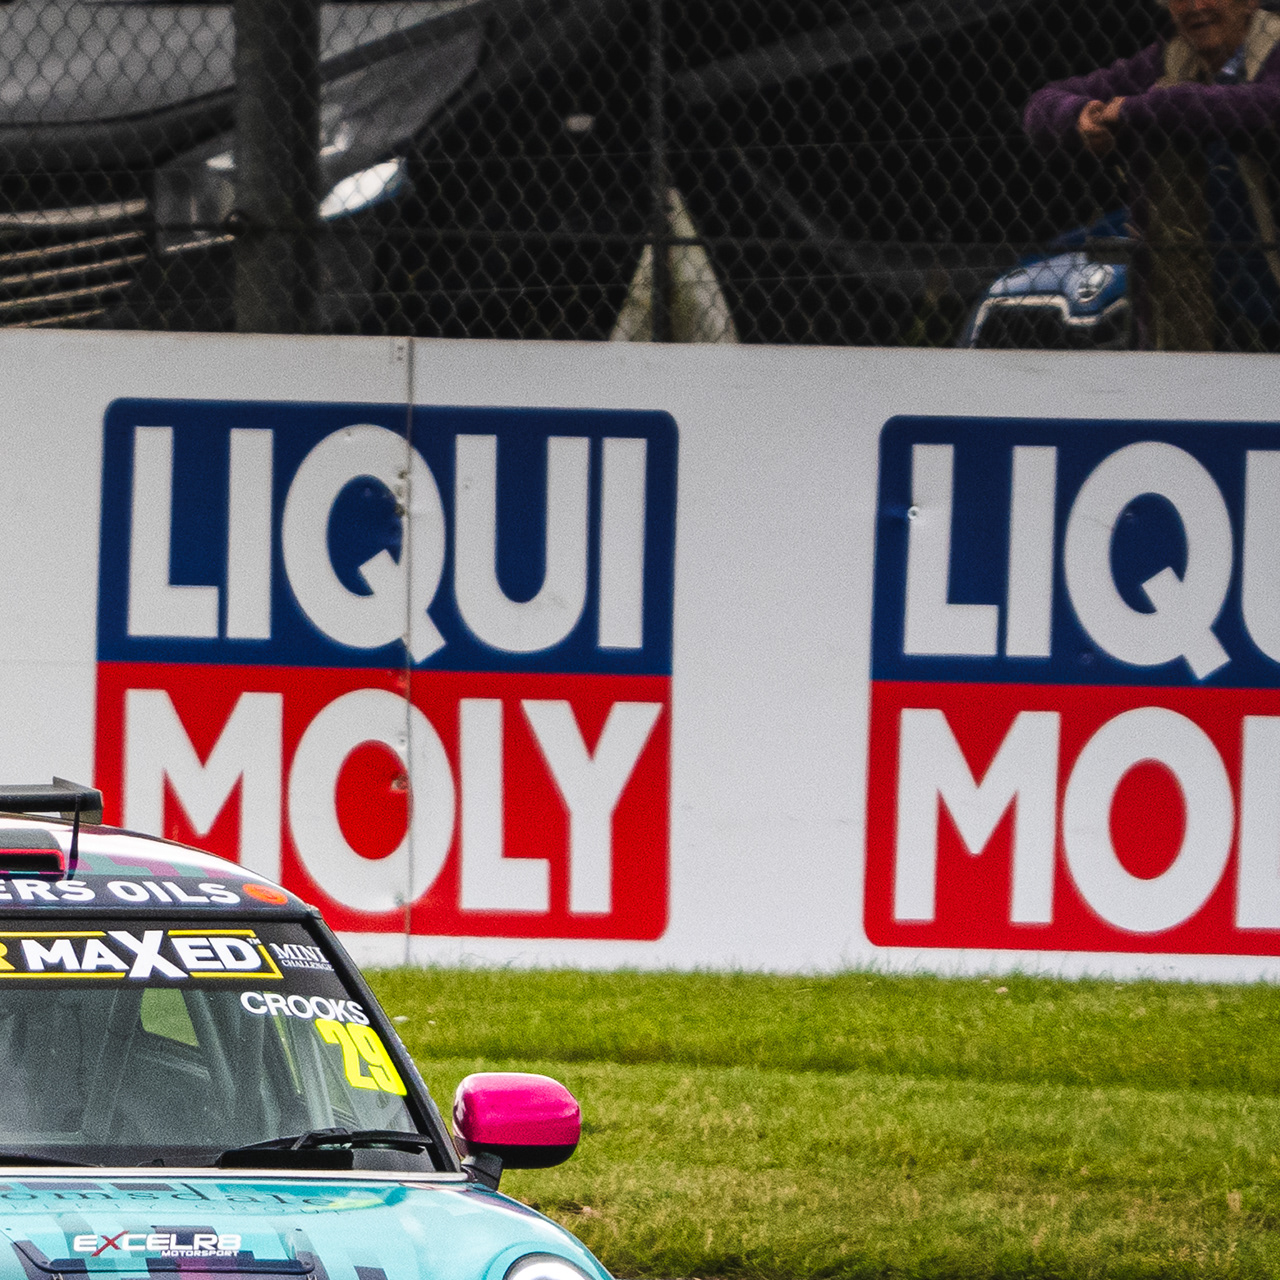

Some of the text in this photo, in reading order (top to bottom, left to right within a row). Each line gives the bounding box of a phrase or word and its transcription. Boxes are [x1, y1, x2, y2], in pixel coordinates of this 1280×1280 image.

[125, 424, 648, 663] LIQUI
[122, 688, 663, 914] MOLY
[107, 880, 242, 904] OILS
[269, 943, 329, 963] MINI
[241, 991, 370, 1026] CROOKS
[315, 1019, 408, 1096] 29
[73, 1230, 242, 1256] EXCELR8
